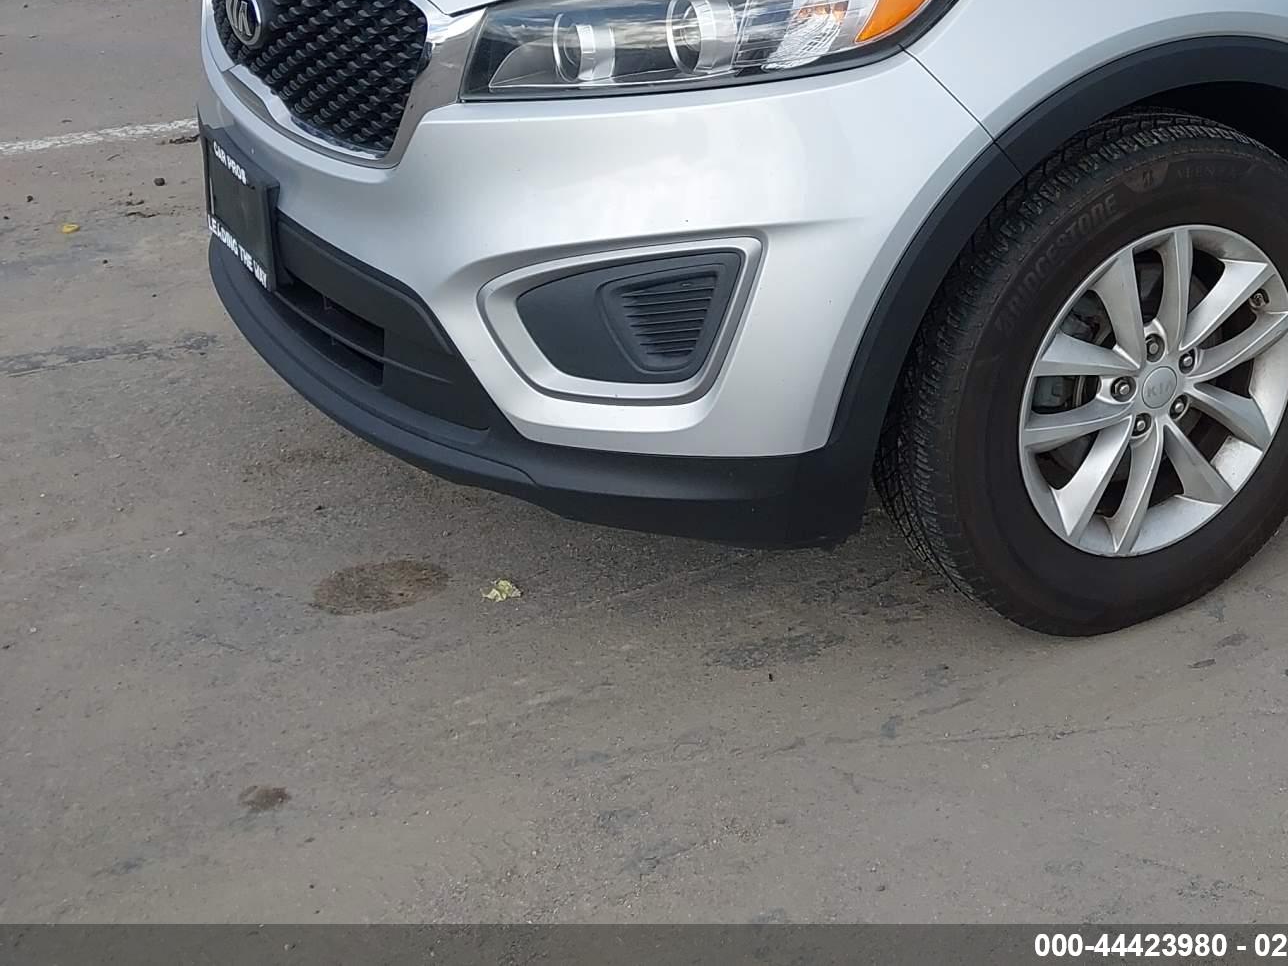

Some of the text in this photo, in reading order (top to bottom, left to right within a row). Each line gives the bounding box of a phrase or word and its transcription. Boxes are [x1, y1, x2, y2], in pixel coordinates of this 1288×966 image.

[213, 140, 247, 185] CAR PROS
[207, 213, 268, 289] LEADING THE WAY
